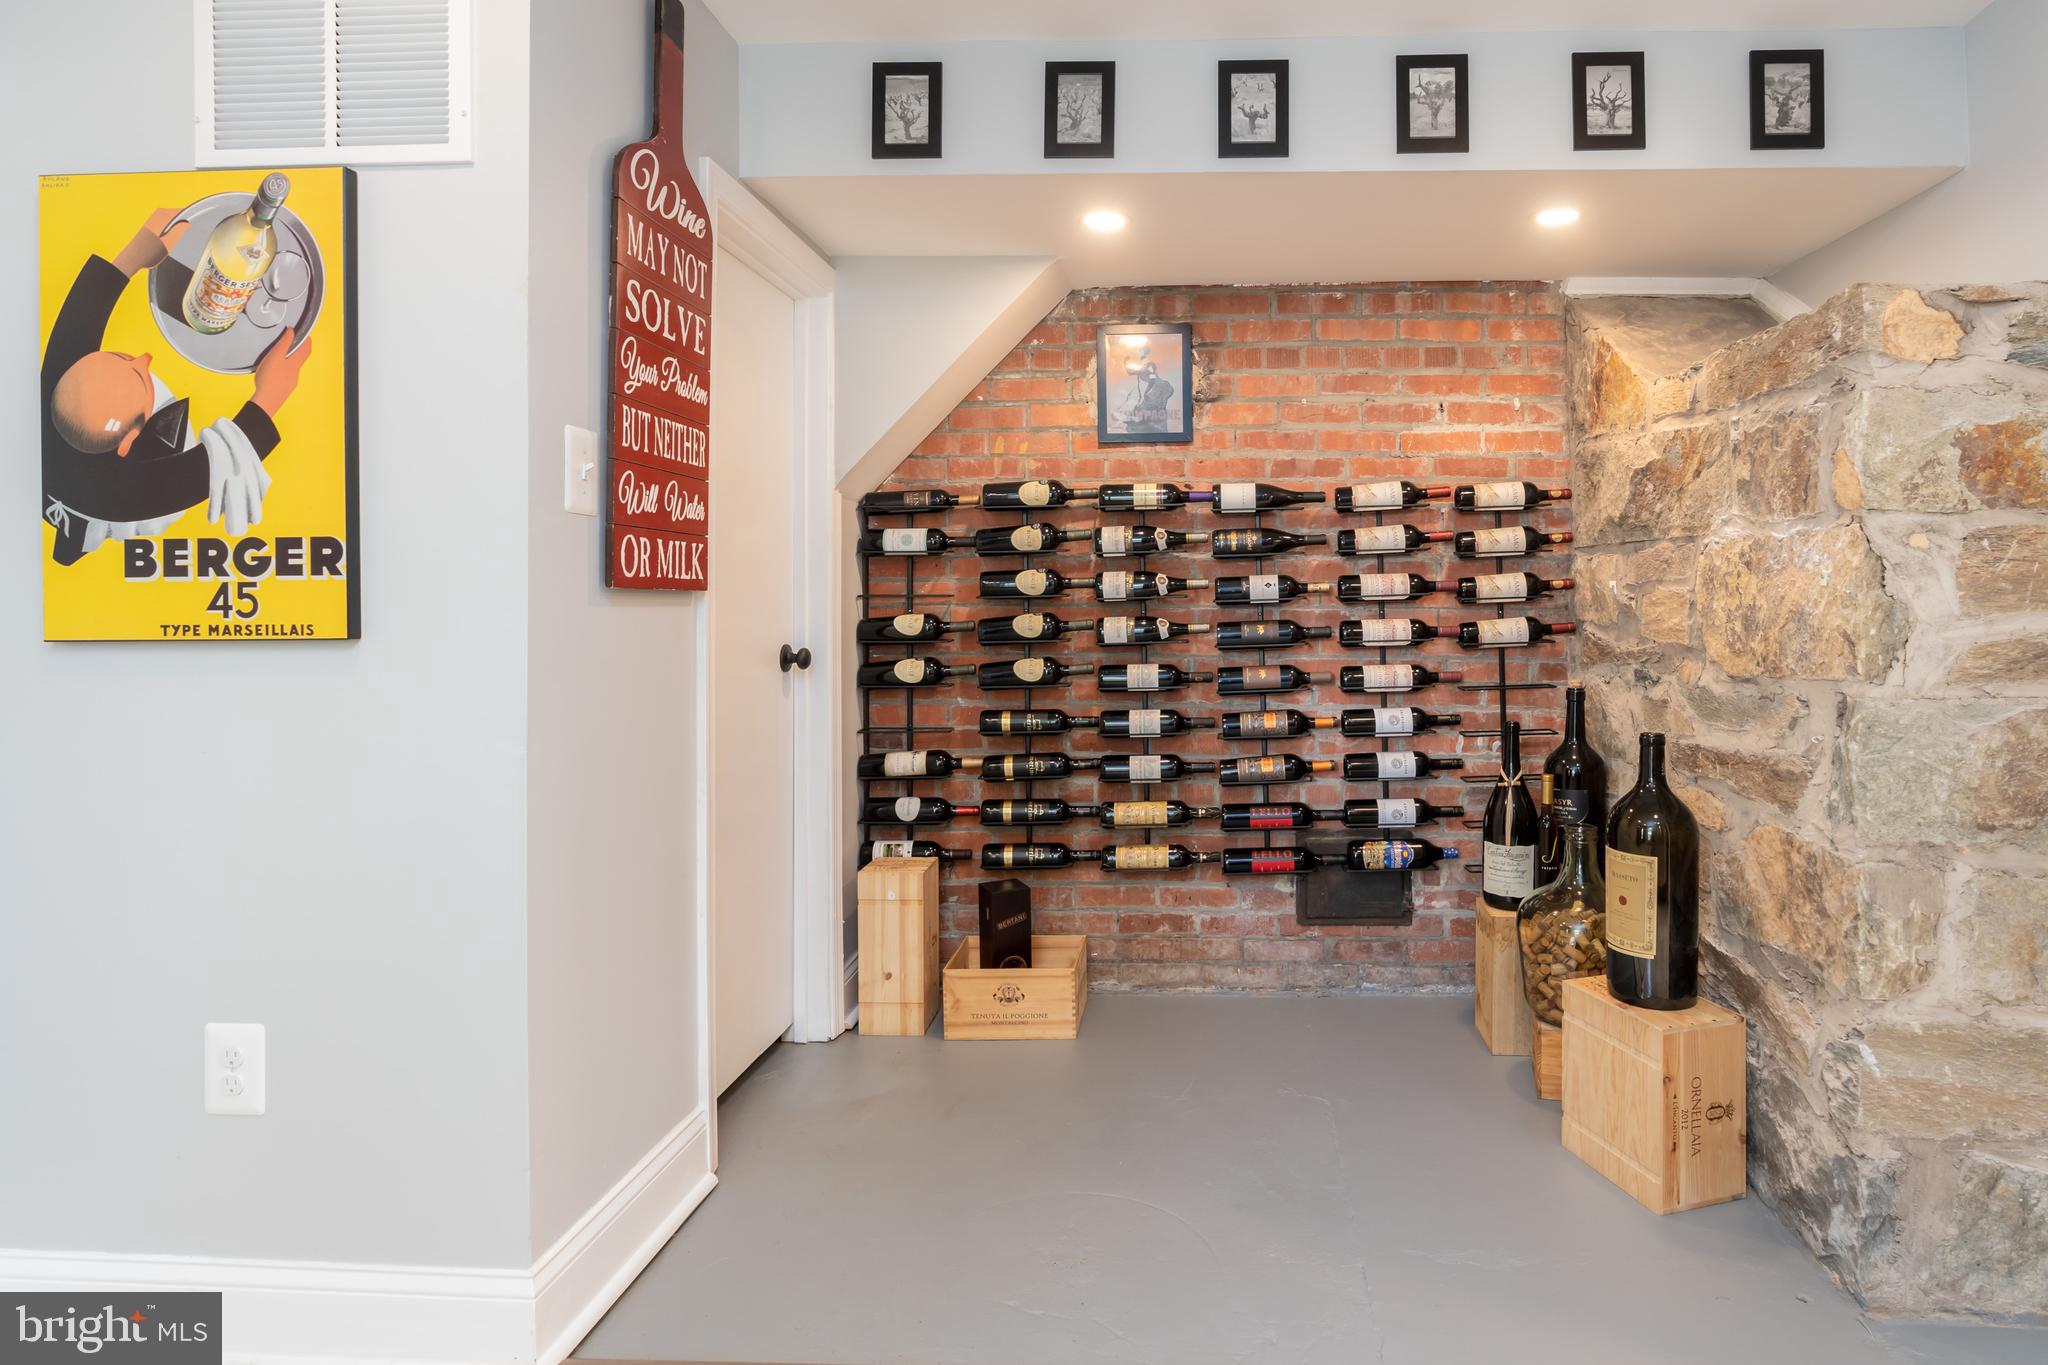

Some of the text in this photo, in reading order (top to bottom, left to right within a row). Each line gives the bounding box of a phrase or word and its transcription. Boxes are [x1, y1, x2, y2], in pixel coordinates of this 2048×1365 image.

[630, 148, 706, 239] Wine
[627, 213, 708, 300] MAY NOT
[625, 279, 706, 356] SOLVE
[621, 336, 709, 406] Your Problem
[621, 404, 706, 468] BUT NEITHER
[618, 470, 705, 522] Will Water
[124, 536, 345, 580] BERGER
[620, 534, 704, 580] OR MILK
[206, 582, 260, 620] 45
[160, 624, 315, 637] TYPE MARSEILLAIS
[1010, 1012, 1048, 1020] POGGIONE
[1681, 1109, 1689, 1130] 2012
[1690, 1076, 1702, 1158] ORNELLAIA
